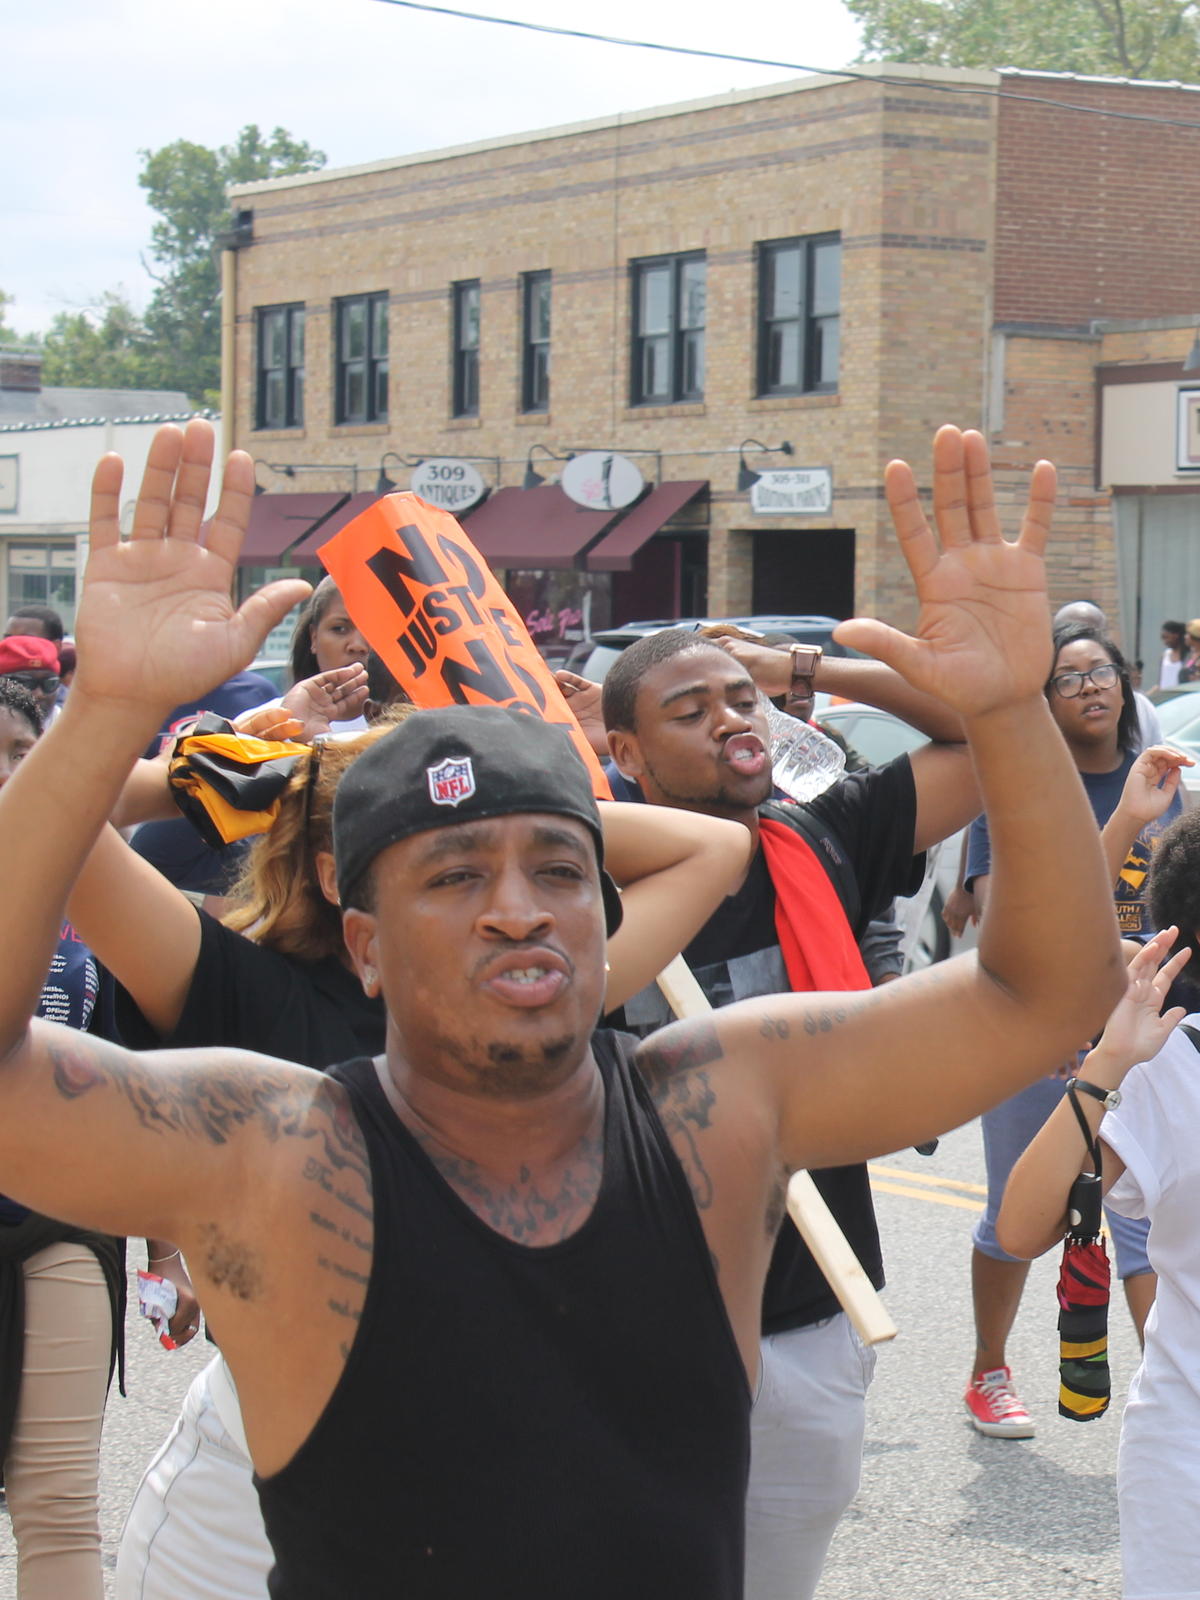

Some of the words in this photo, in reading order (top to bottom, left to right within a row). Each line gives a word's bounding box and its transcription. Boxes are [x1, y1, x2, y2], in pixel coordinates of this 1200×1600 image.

[427, 465, 465, 481] 309
[419, 484, 476, 506] ANTIQUES
[434, 775, 471, 800] NFL
